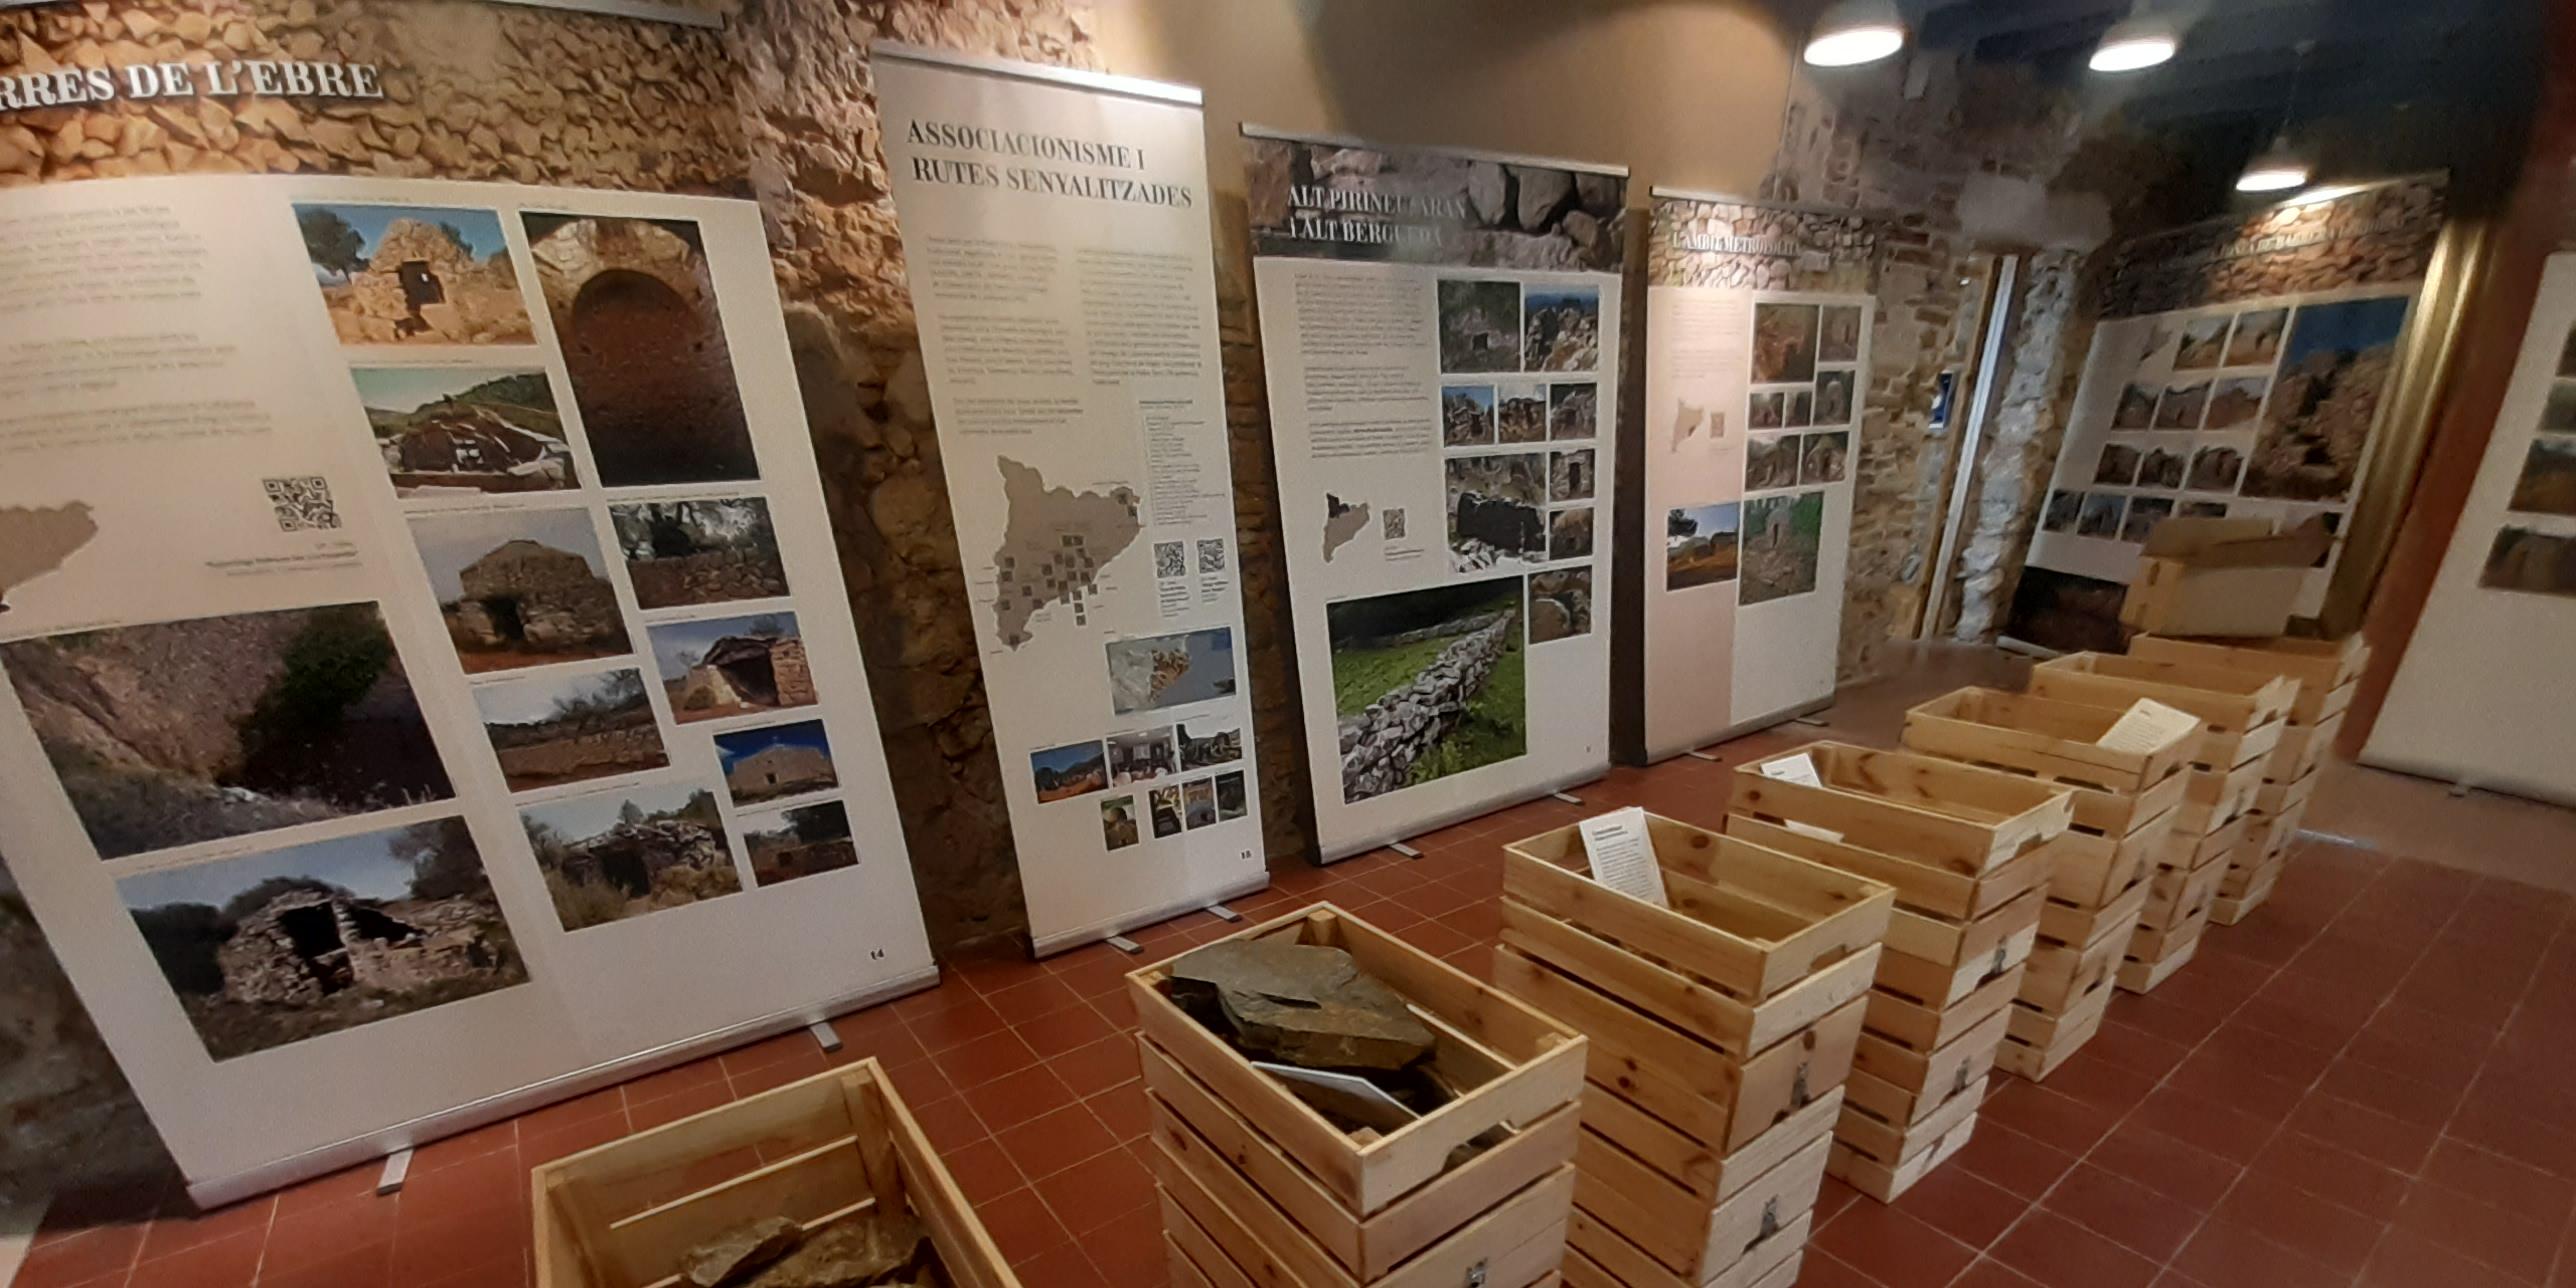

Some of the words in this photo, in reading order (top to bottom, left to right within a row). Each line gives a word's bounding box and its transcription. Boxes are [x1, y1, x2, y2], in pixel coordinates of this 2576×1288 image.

[126, 62, 194, 99] DE
[206, 58, 384, 100] L'EBRE
[906, 118, 1132, 169] ASSOCIACIONISME
[1136, 149, 1145, 170] I
[911, 156, 1000, 187] RUTES
[1006, 167, 1193, 208] SENYALITZADES
[1288, 184, 1326, 208] ALT
[1289, 216, 1298, 239] I
[1299, 217, 1338, 241] ALT
[869, 948, 885, 961] 14
